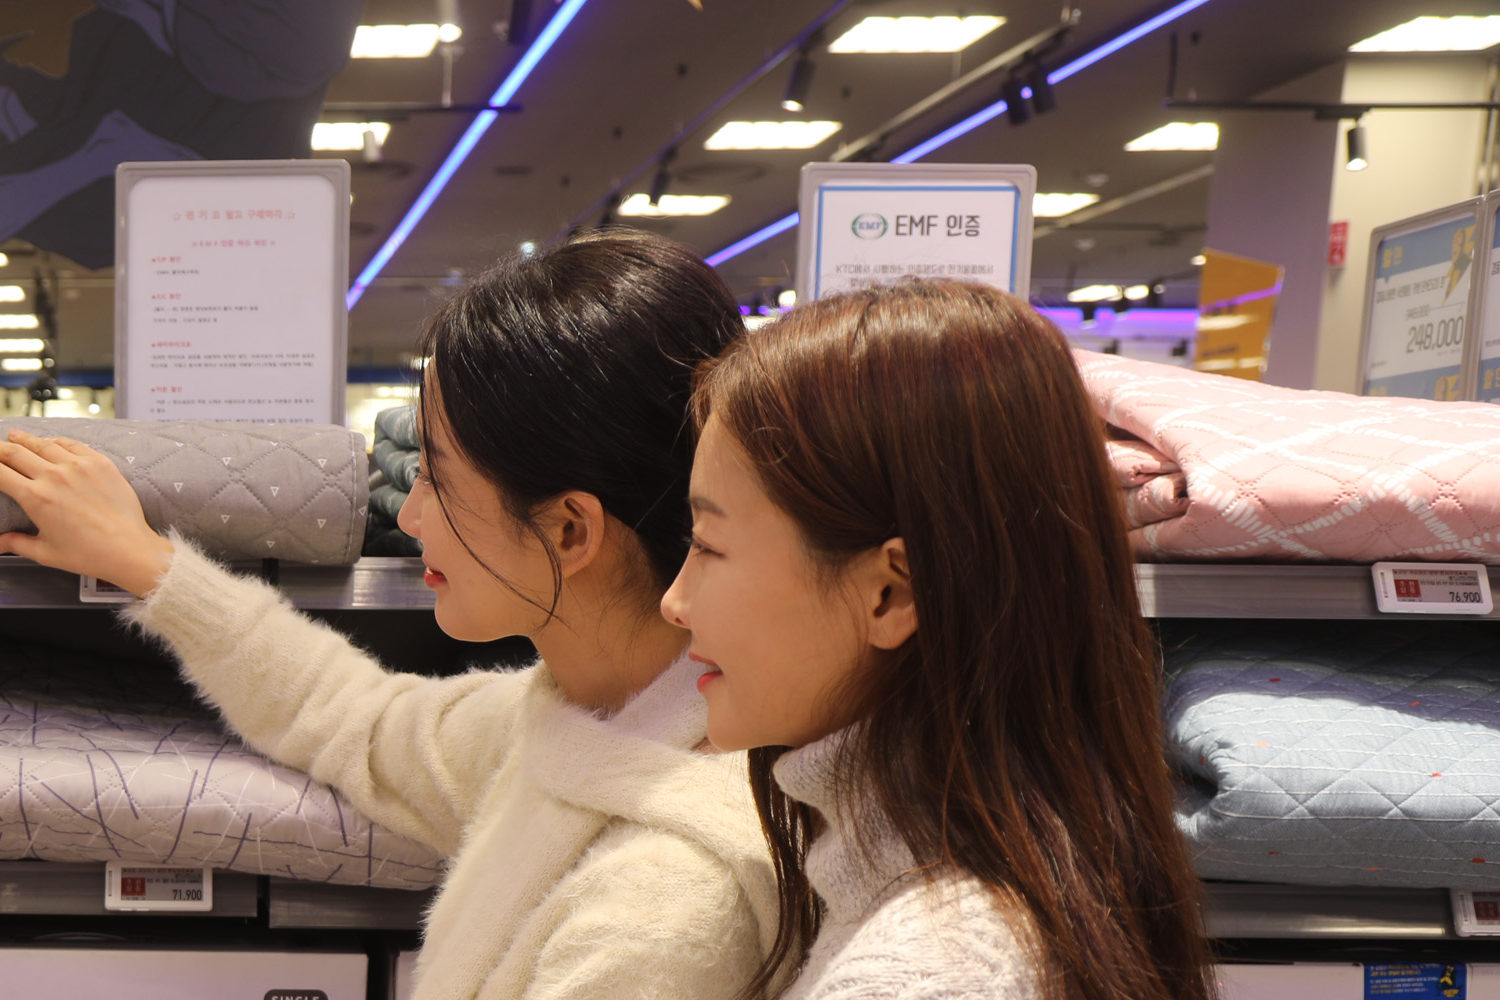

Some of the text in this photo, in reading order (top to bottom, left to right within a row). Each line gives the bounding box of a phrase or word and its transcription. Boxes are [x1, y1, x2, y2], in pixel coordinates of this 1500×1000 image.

[895, 215, 980, 237] EMF 인증
[1406, 316, 1464, 353] 248,000
[1448, 591, 1481, 603] 76.900
[172, 889, 202, 900] 71.900
